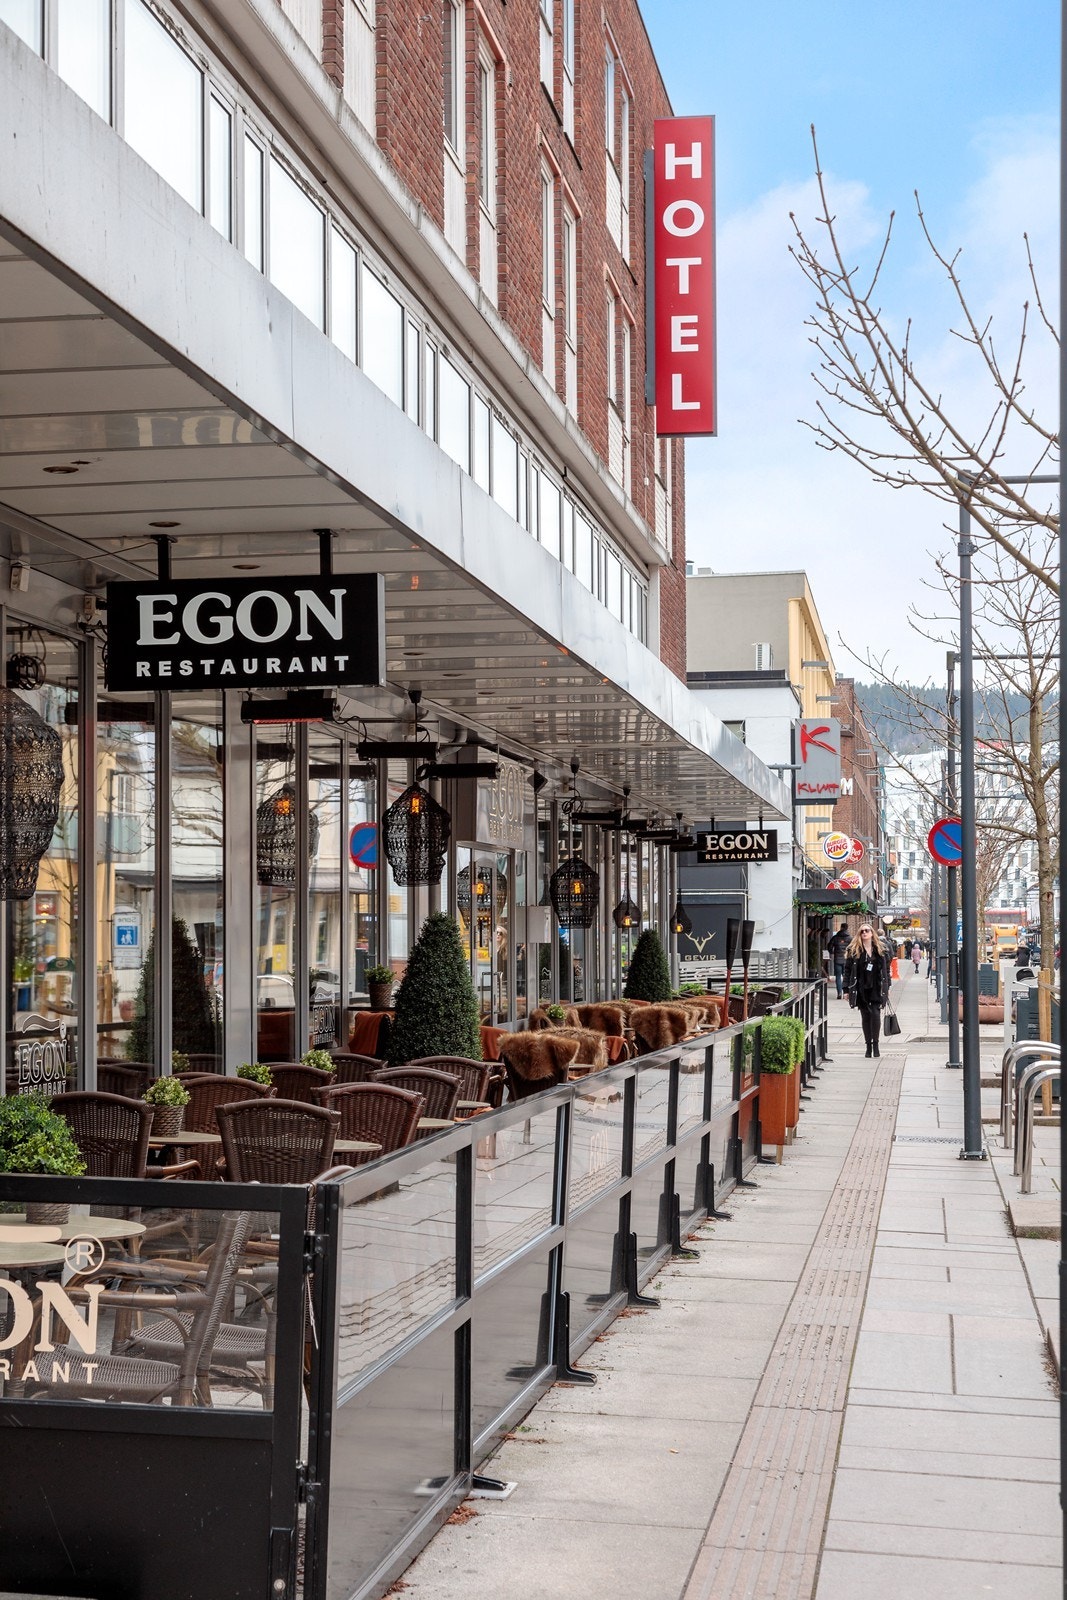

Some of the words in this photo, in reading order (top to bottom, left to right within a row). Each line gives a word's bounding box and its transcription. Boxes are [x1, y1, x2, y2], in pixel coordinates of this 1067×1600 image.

[663, 142, 705, 410] HOTEL
[136, 588, 347, 646] EGON
[136, 655, 349, 677] RESTAURANT
[801, 724, 837, 764] K
[705, 833, 769, 851] EGON
[705, 852, 770, 860] RESTAURANT
[827, 843, 848, 855] KING
[18, 1039, 67, 1085] EGON
